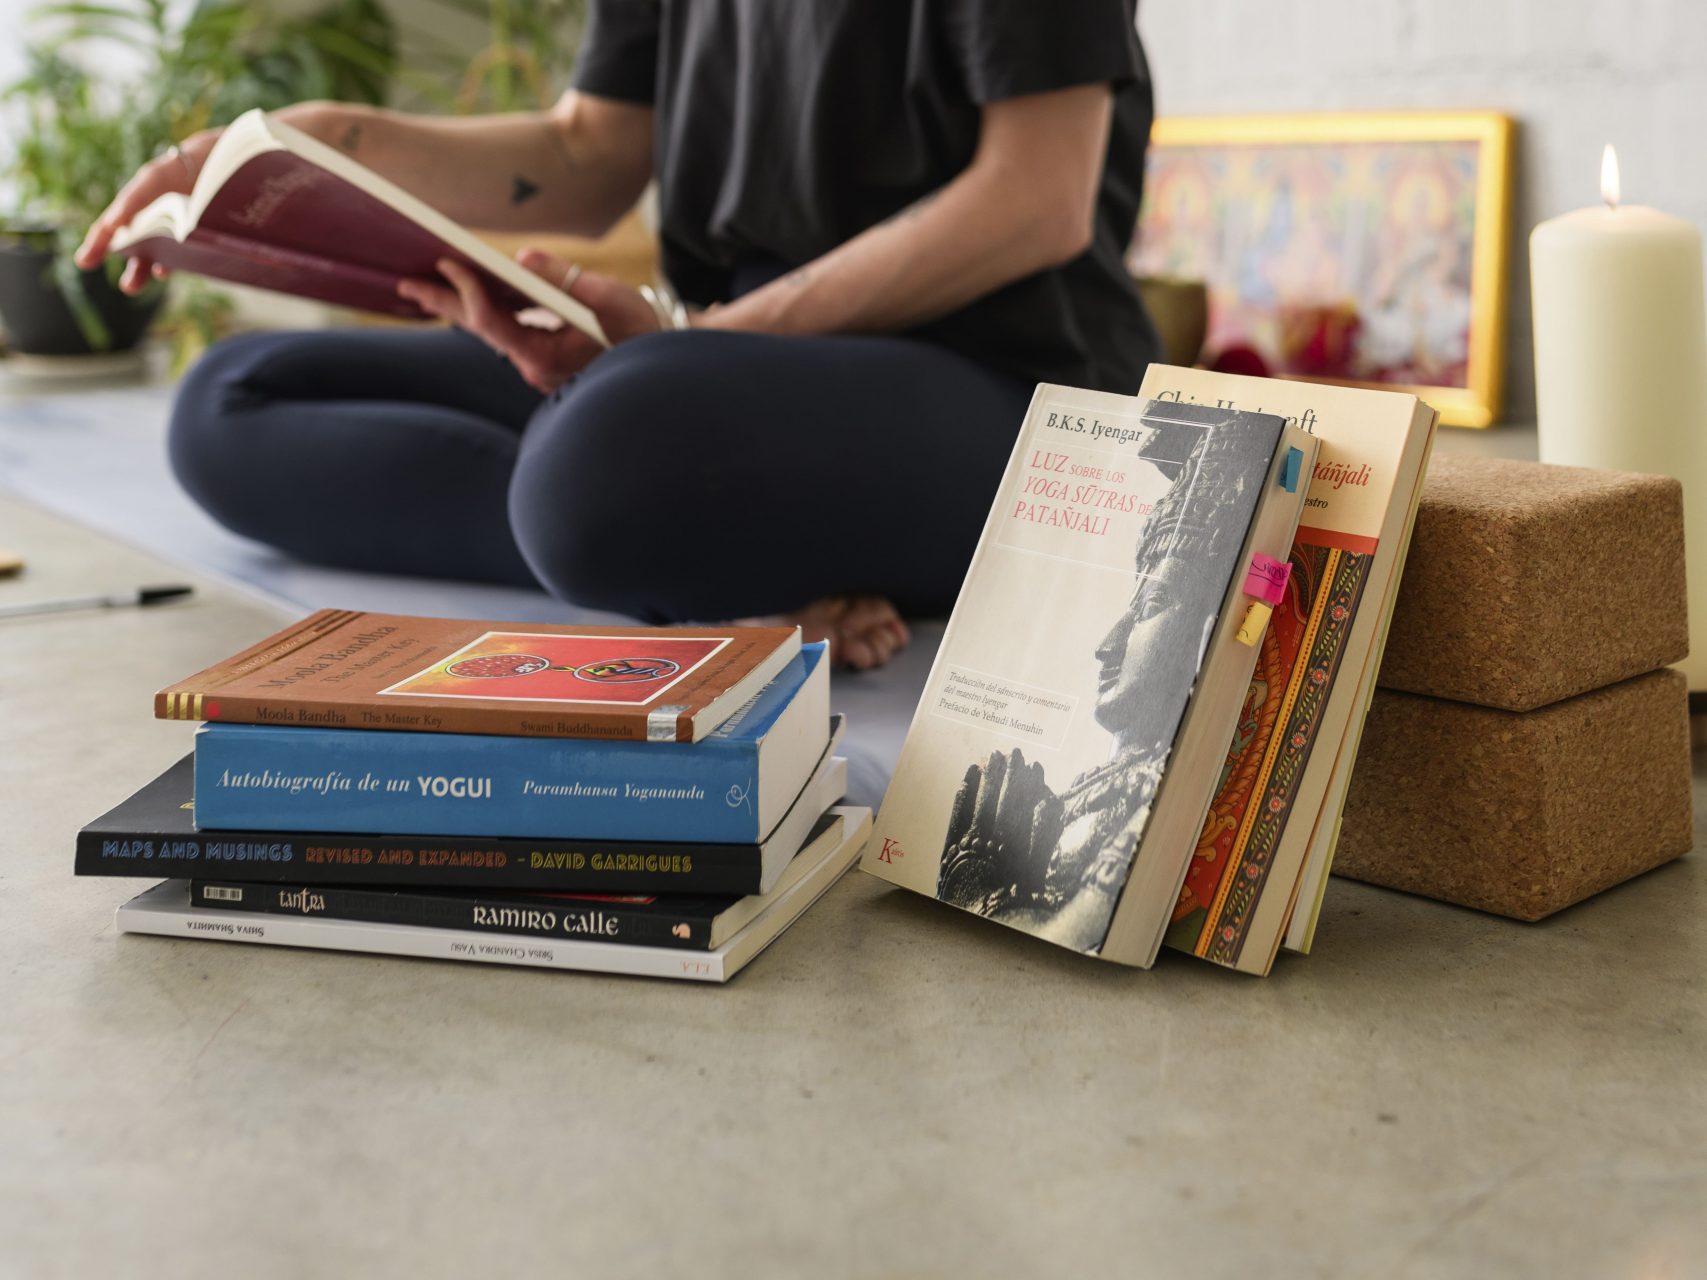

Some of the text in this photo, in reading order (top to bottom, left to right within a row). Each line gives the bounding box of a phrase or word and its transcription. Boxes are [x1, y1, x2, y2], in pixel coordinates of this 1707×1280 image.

[1046, 412, 1143, 444] B.K.S. Iyengar
[1030, 450, 1126, 483] LUZ SOBRE LOS
[1311, 461, 1372, 490] táñjali
[1022, 476, 1153, 516] YOGA SŪTRAS DE
[1012, 500, 1111, 536] PATAÑJALI
[319, 625, 398, 661] Bandha
[944, 684, 1009, 710] del maestro Iyengar
[949, 671, 986, 689] Traducción
[986, 683, 998, 693] del
[1025, 694, 1033, 704] y
[1032, 697, 1071, 713] comentario
[255, 706, 347, 724] Moola Bandha
[361, 711, 443, 728] The Master Key
[520, 721, 633, 737] Swami Buddhananda
[938, 697, 1044, 736] Prefacio de Yehudi Menuhin
[216, 768, 492, 799] Autobiografía de un YOGUI
[523, 779, 705, 801] Paramhansa Yogananda
[102, 839, 293, 862] MAPS AND MUSINGS
[305, 847, 373, 865] REVISED
[377, 848, 414, 866] AND
[418, 849, 507, 867] EXPANDED
[530, 852, 586, 870] DAVID
[591, 853, 693, 873] GARRIGUES
